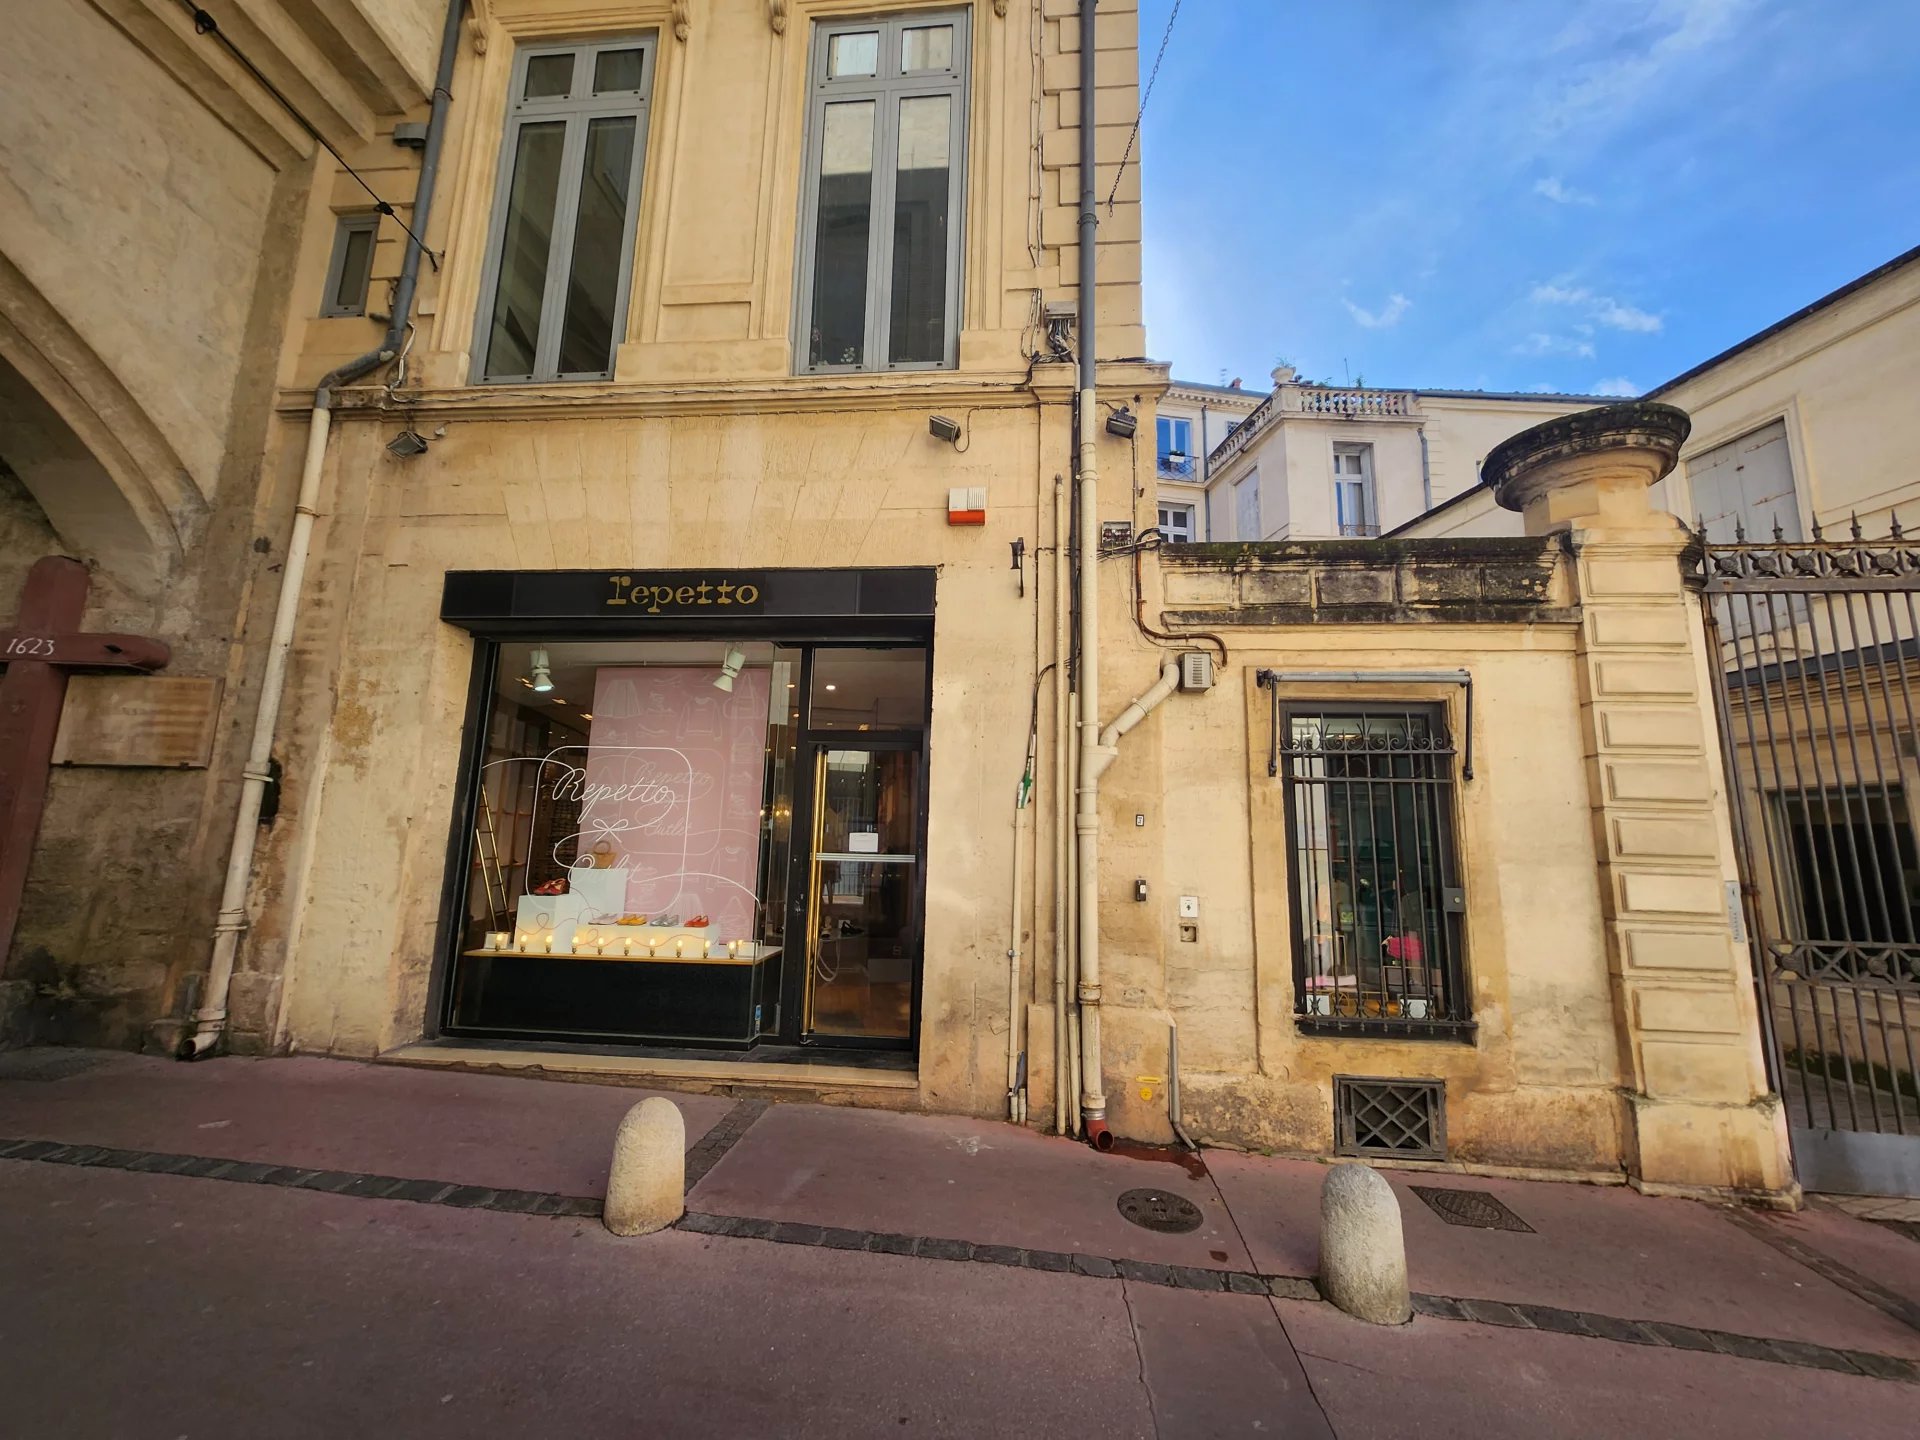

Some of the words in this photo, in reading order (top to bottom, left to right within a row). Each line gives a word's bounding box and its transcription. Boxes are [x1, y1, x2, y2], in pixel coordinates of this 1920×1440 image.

[606, 575, 759, 613] repetto
[6, 637, 55, 656] 1623
[552, 768, 675, 824] Repetto
